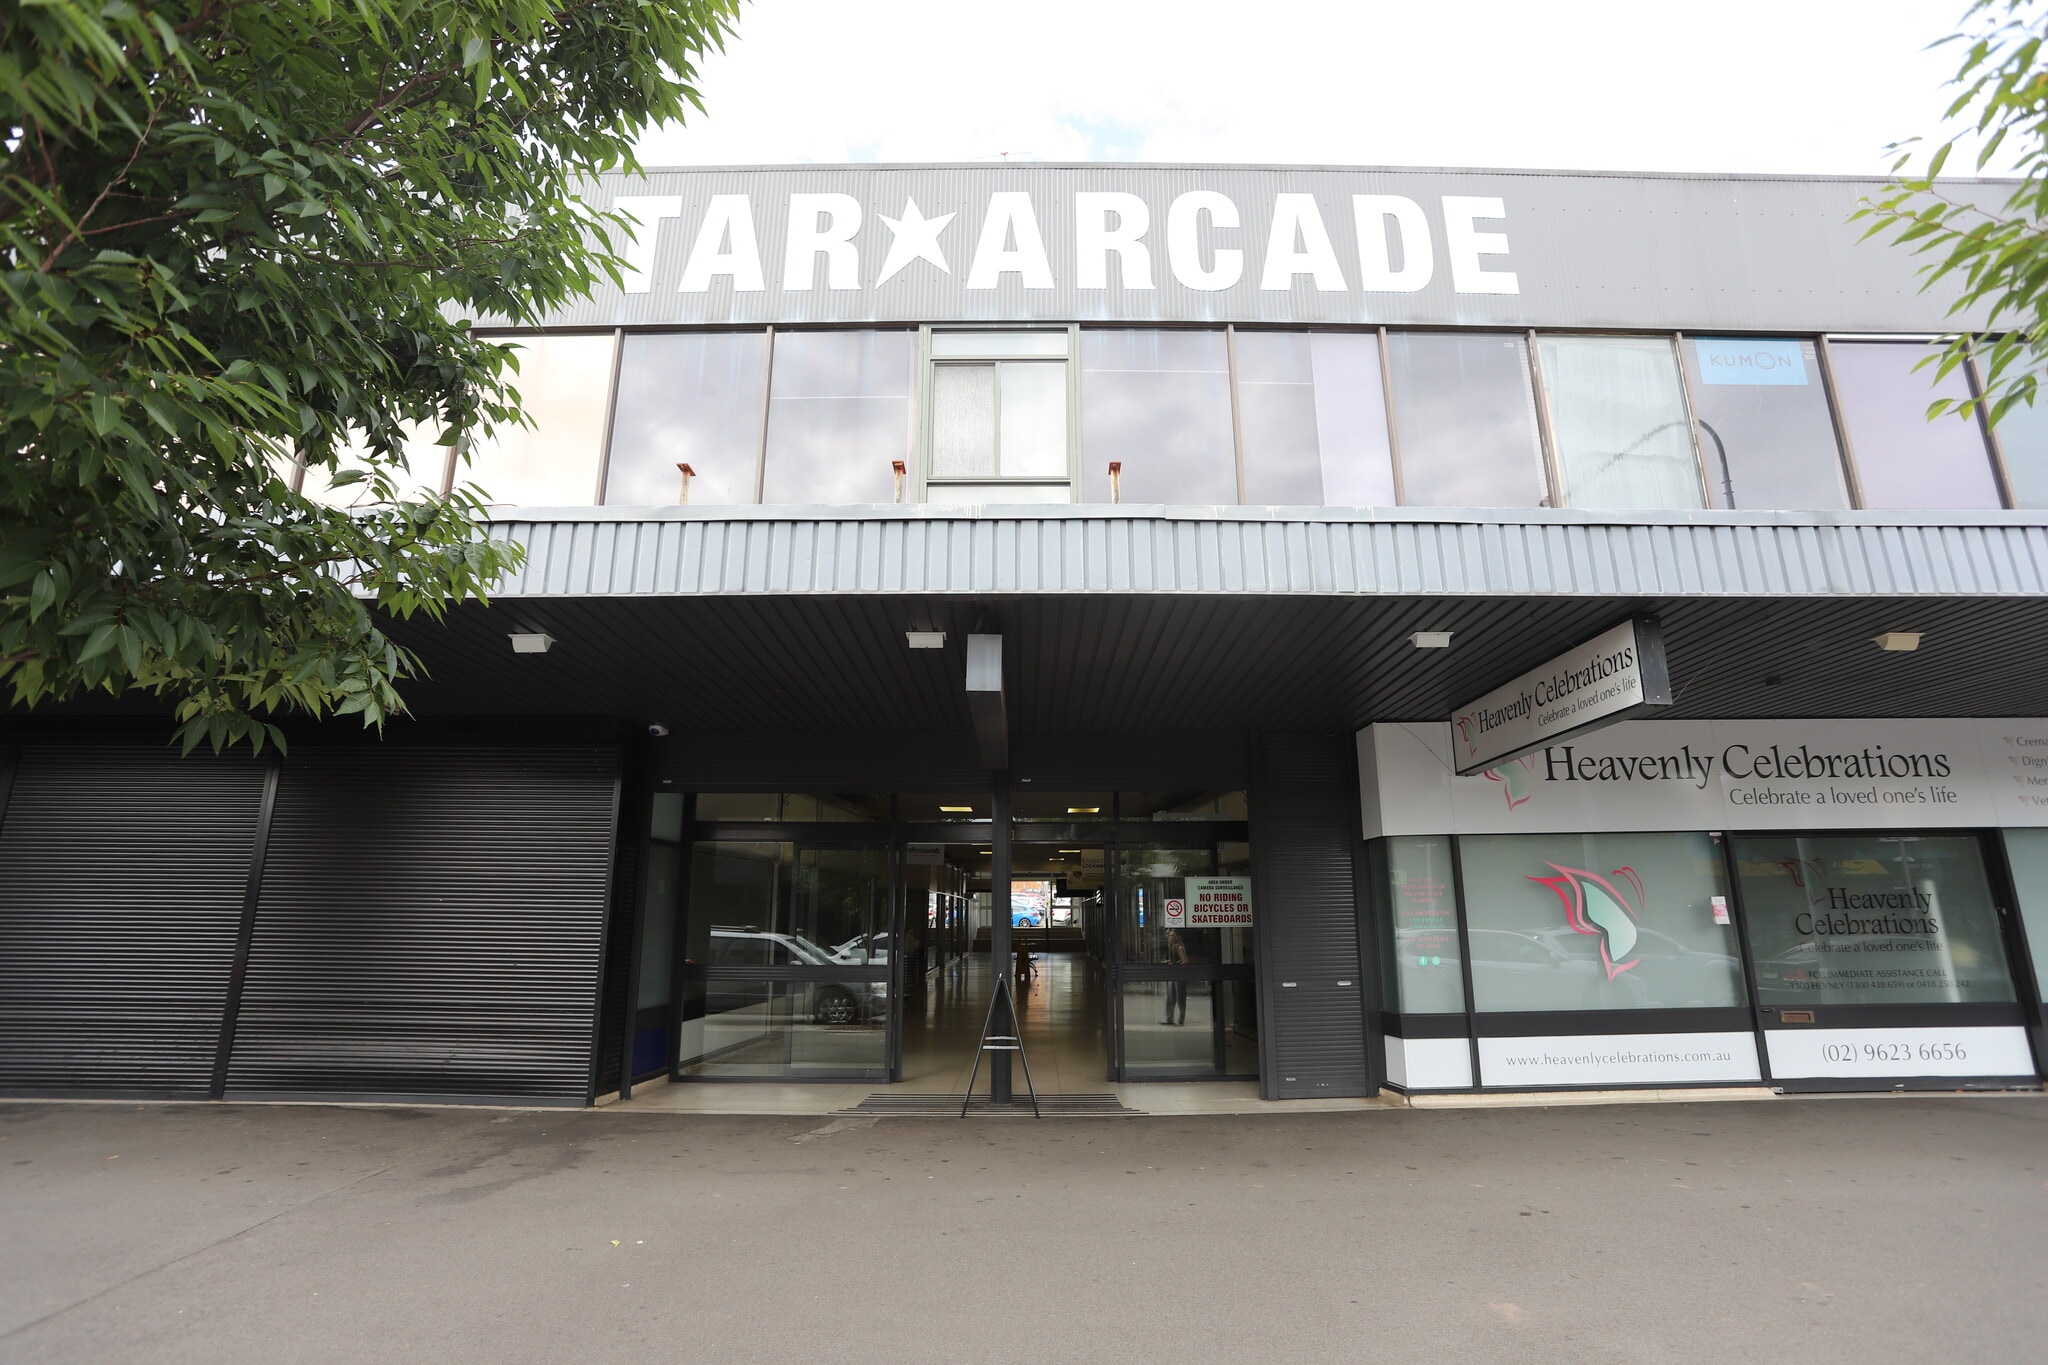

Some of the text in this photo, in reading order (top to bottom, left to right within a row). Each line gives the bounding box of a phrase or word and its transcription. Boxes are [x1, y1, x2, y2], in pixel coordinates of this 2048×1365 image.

[562, 190, 1520, 295] TAR ARCADE
[1709, 352, 1792, 370] KUMON
[1478, 647, 1633, 734] Heavenly Celebrations
[1537, 675, 1637, 727] Celebrate a loved one's life
[1544, 744, 1951, 790] Heavenly Celebrations
[2021, 755, 2048, 770] Dign
[1729, 785, 1957, 806] Celebrate a loved one's life
[1199, 893, 1243, 902] NO RIDING
[1827, 886, 1932, 914] Heavenly
[1194, 903, 1249, 913] BICYCLES OR
[1192, 914, 1252, 924] SKATEBOARDS
[1795, 913, 1939, 936] Celebrations
[1800, 941, 1851, 953] Celebrate
[1863, 940, 1893, 953] loved
[1895, 939, 1924, 952] one's
[1926, 939, 1943, 952] life
[1828, 969, 1874, 979] IMMEDIATE
[1876, 969, 1924, 978] ASSISTANCE
[1925, 968, 1947, 977] CALL
[1506, 1051, 1731, 1068] www.heavenlycelebrations.com.au
[1822, 1042, 1967, 1063] (02) 9623 6656
